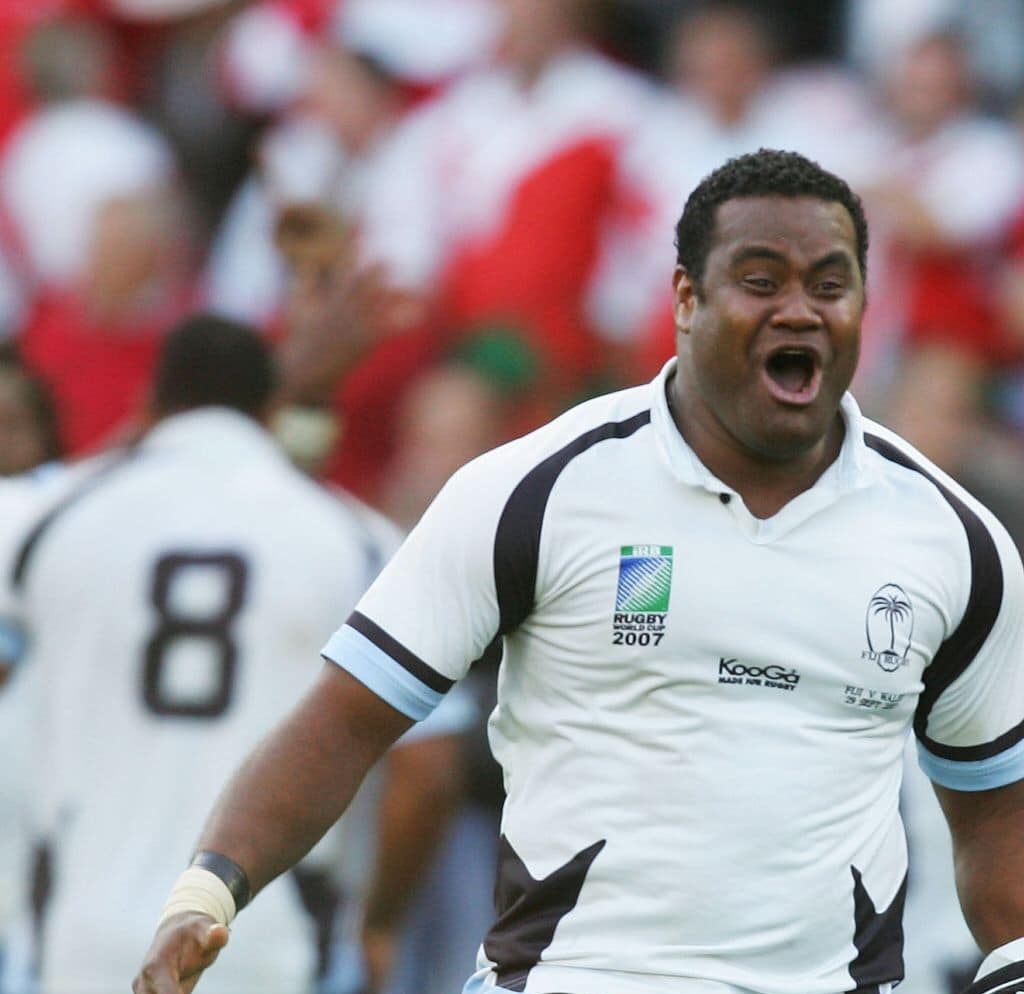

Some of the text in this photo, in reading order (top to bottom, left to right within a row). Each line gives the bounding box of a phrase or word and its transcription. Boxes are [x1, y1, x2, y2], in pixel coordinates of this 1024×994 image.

[613, 613, 667, 624] RUGBY
[144, 552, 248, 718] 8
[612, 631, 665, 646] 2007
[719, 658, 800, 684] KooGa
[718, 677, 743, 685] MADE
[764, 680, 796, 691] RUGBY
